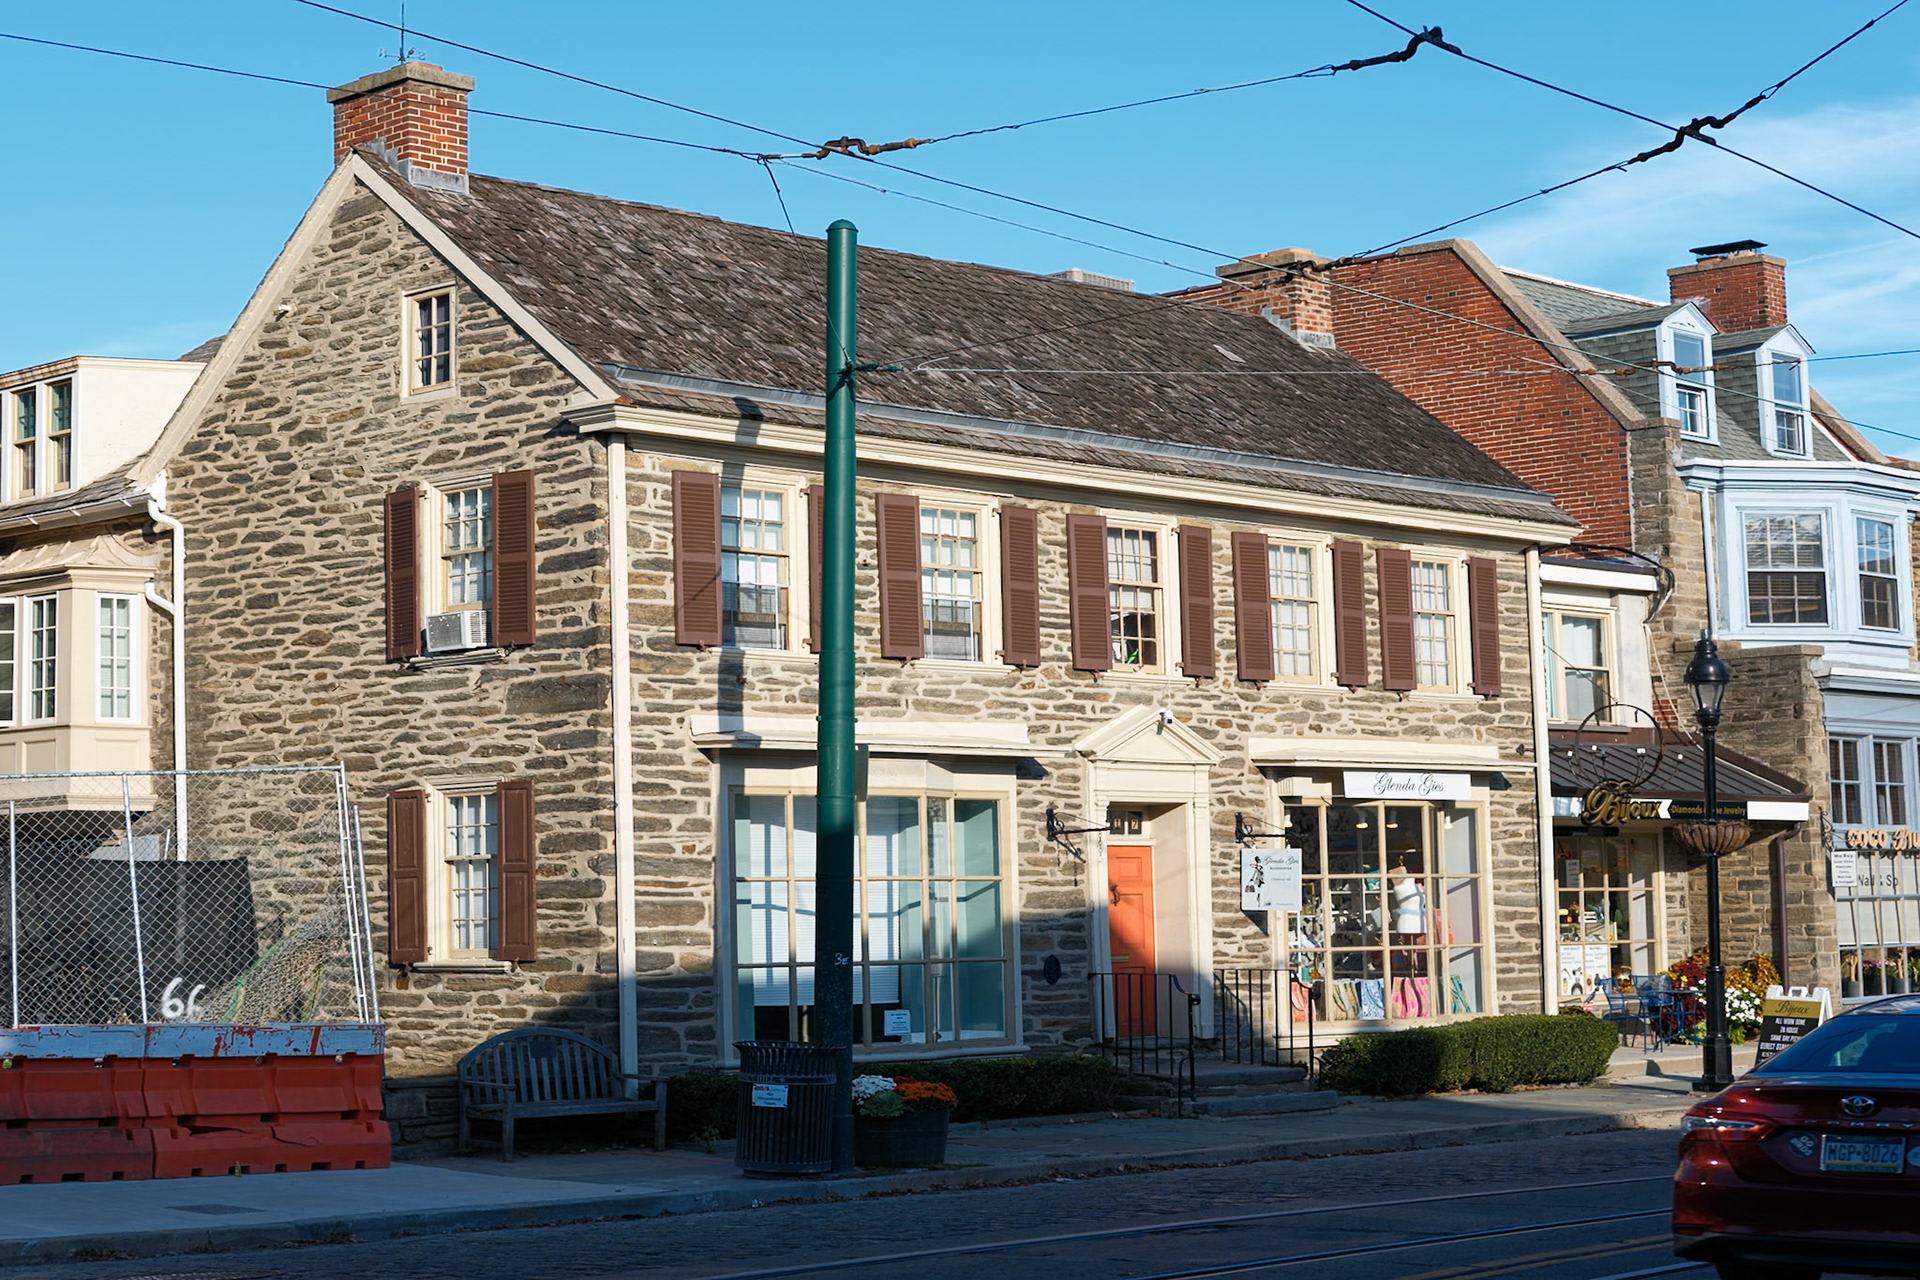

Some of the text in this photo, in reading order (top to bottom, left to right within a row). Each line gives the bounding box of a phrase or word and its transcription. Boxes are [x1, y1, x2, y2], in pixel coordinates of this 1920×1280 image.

[1373, 771, 1444, 797] Glenda Gies
[1581, 779, 1660, 824] Bijoux
[1671, 804, 1702, 814] Diamonds
[1723, 805, 1746, 816] Jewelry
[1775, 1000, 1810, 1017] Bijoux
